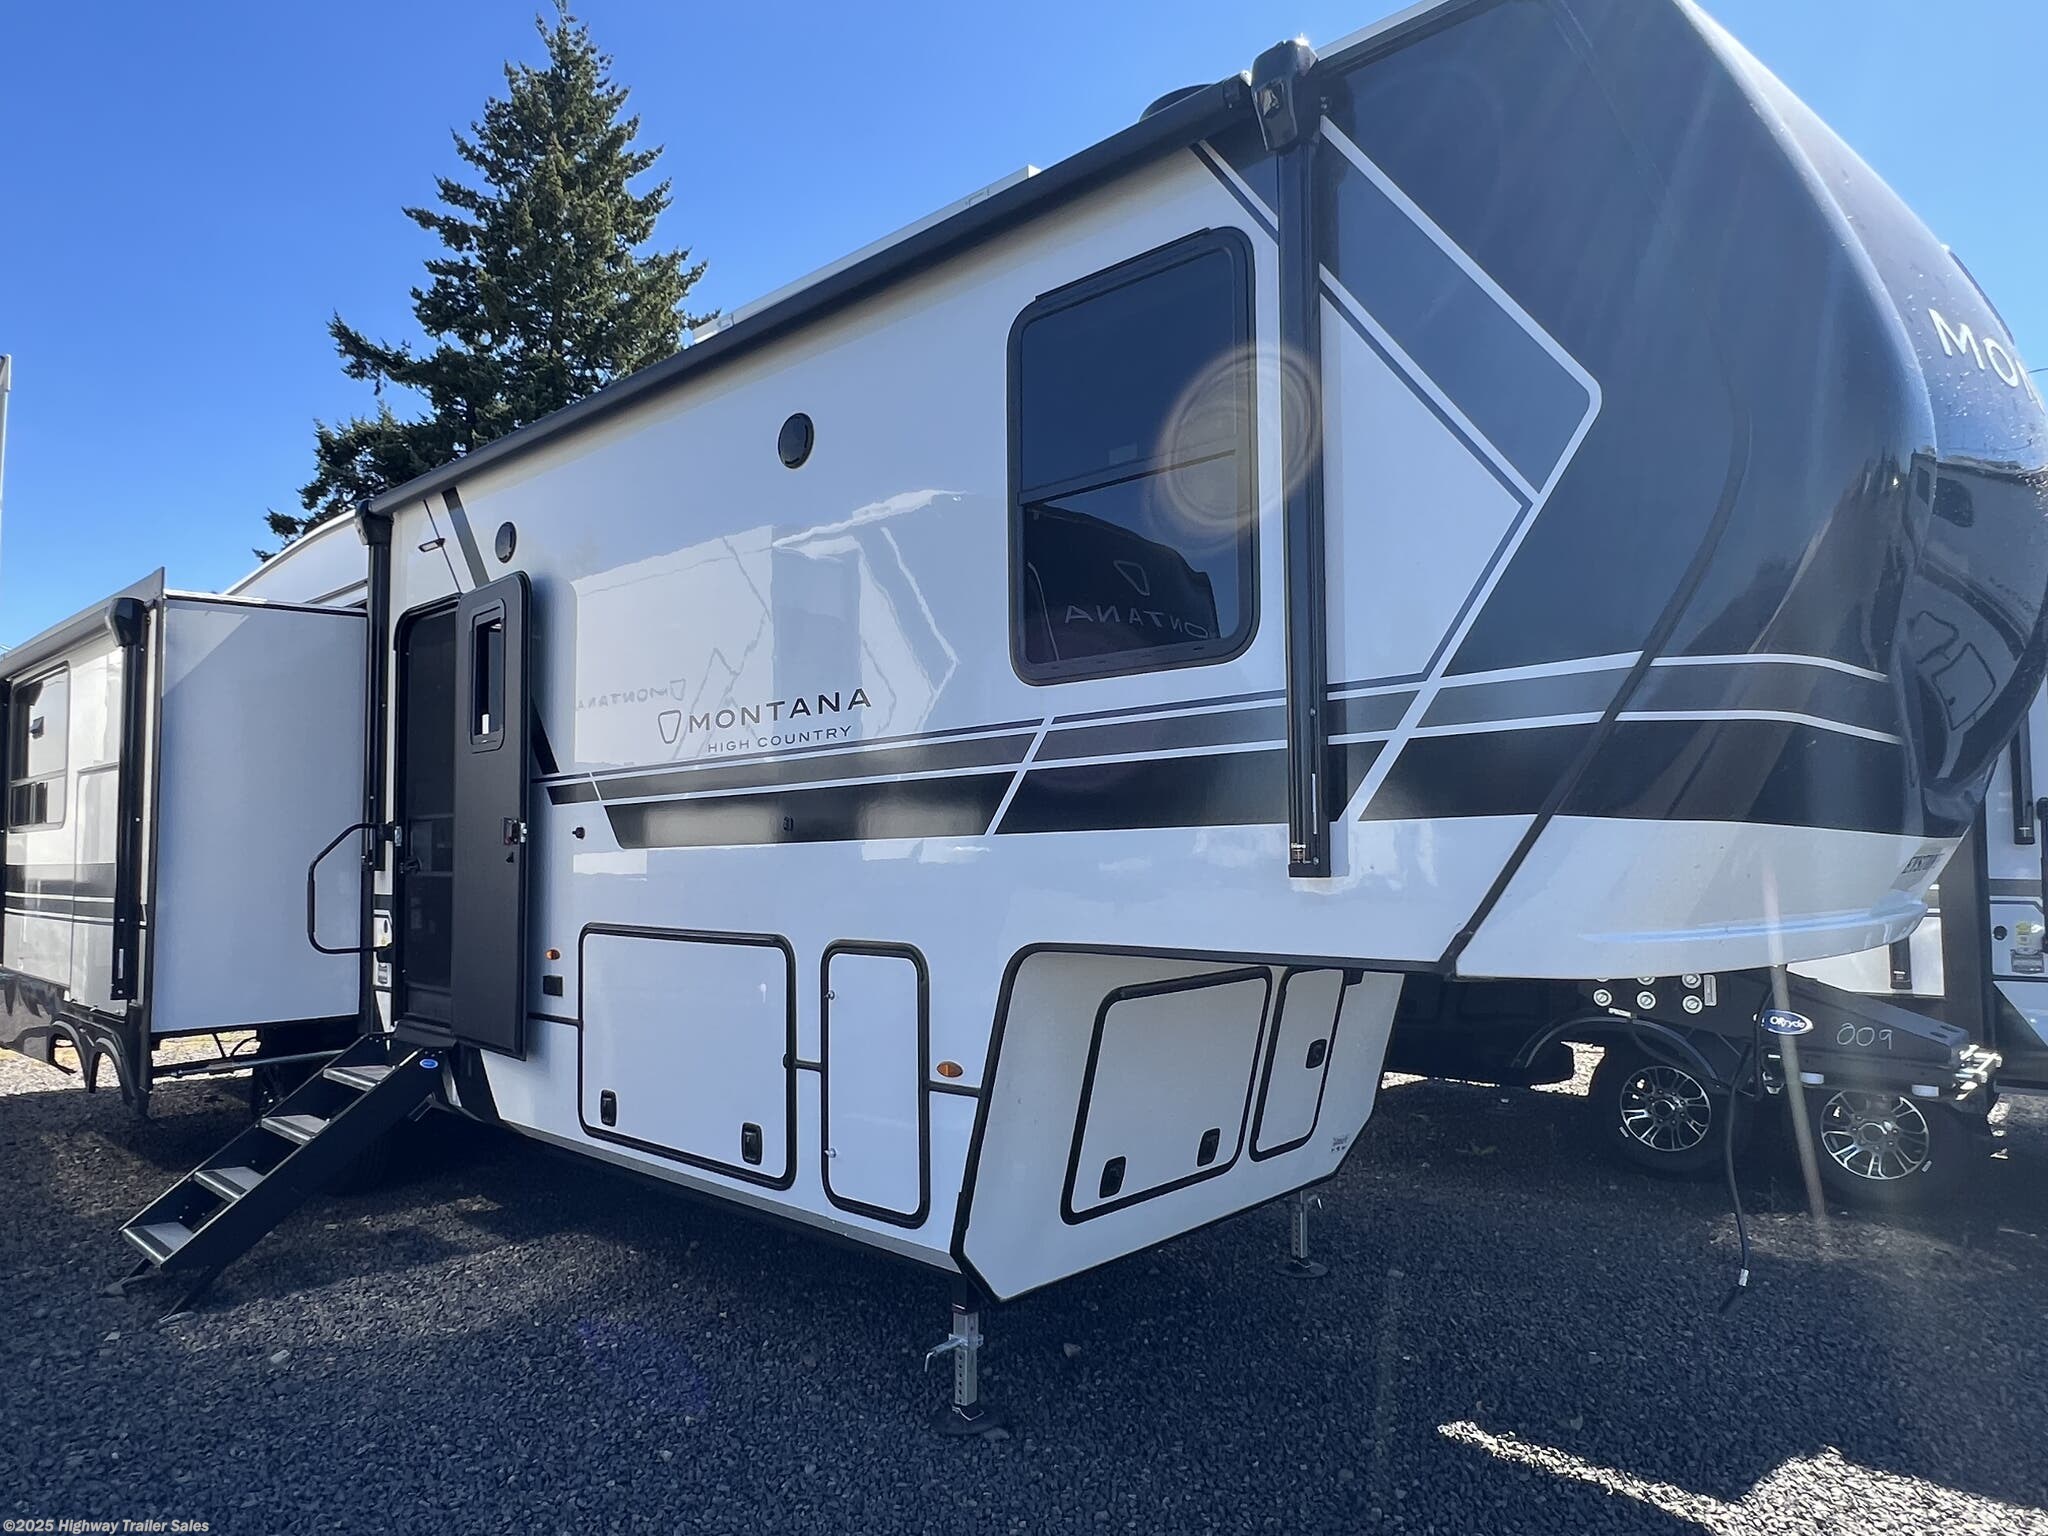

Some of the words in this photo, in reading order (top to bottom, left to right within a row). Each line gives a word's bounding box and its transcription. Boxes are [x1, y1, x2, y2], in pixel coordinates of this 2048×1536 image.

[688, 688, 872, 733] MONTANA
[708, 739, 750, 753] HIGH
[757, 725, 853, 748] COUNTRY
